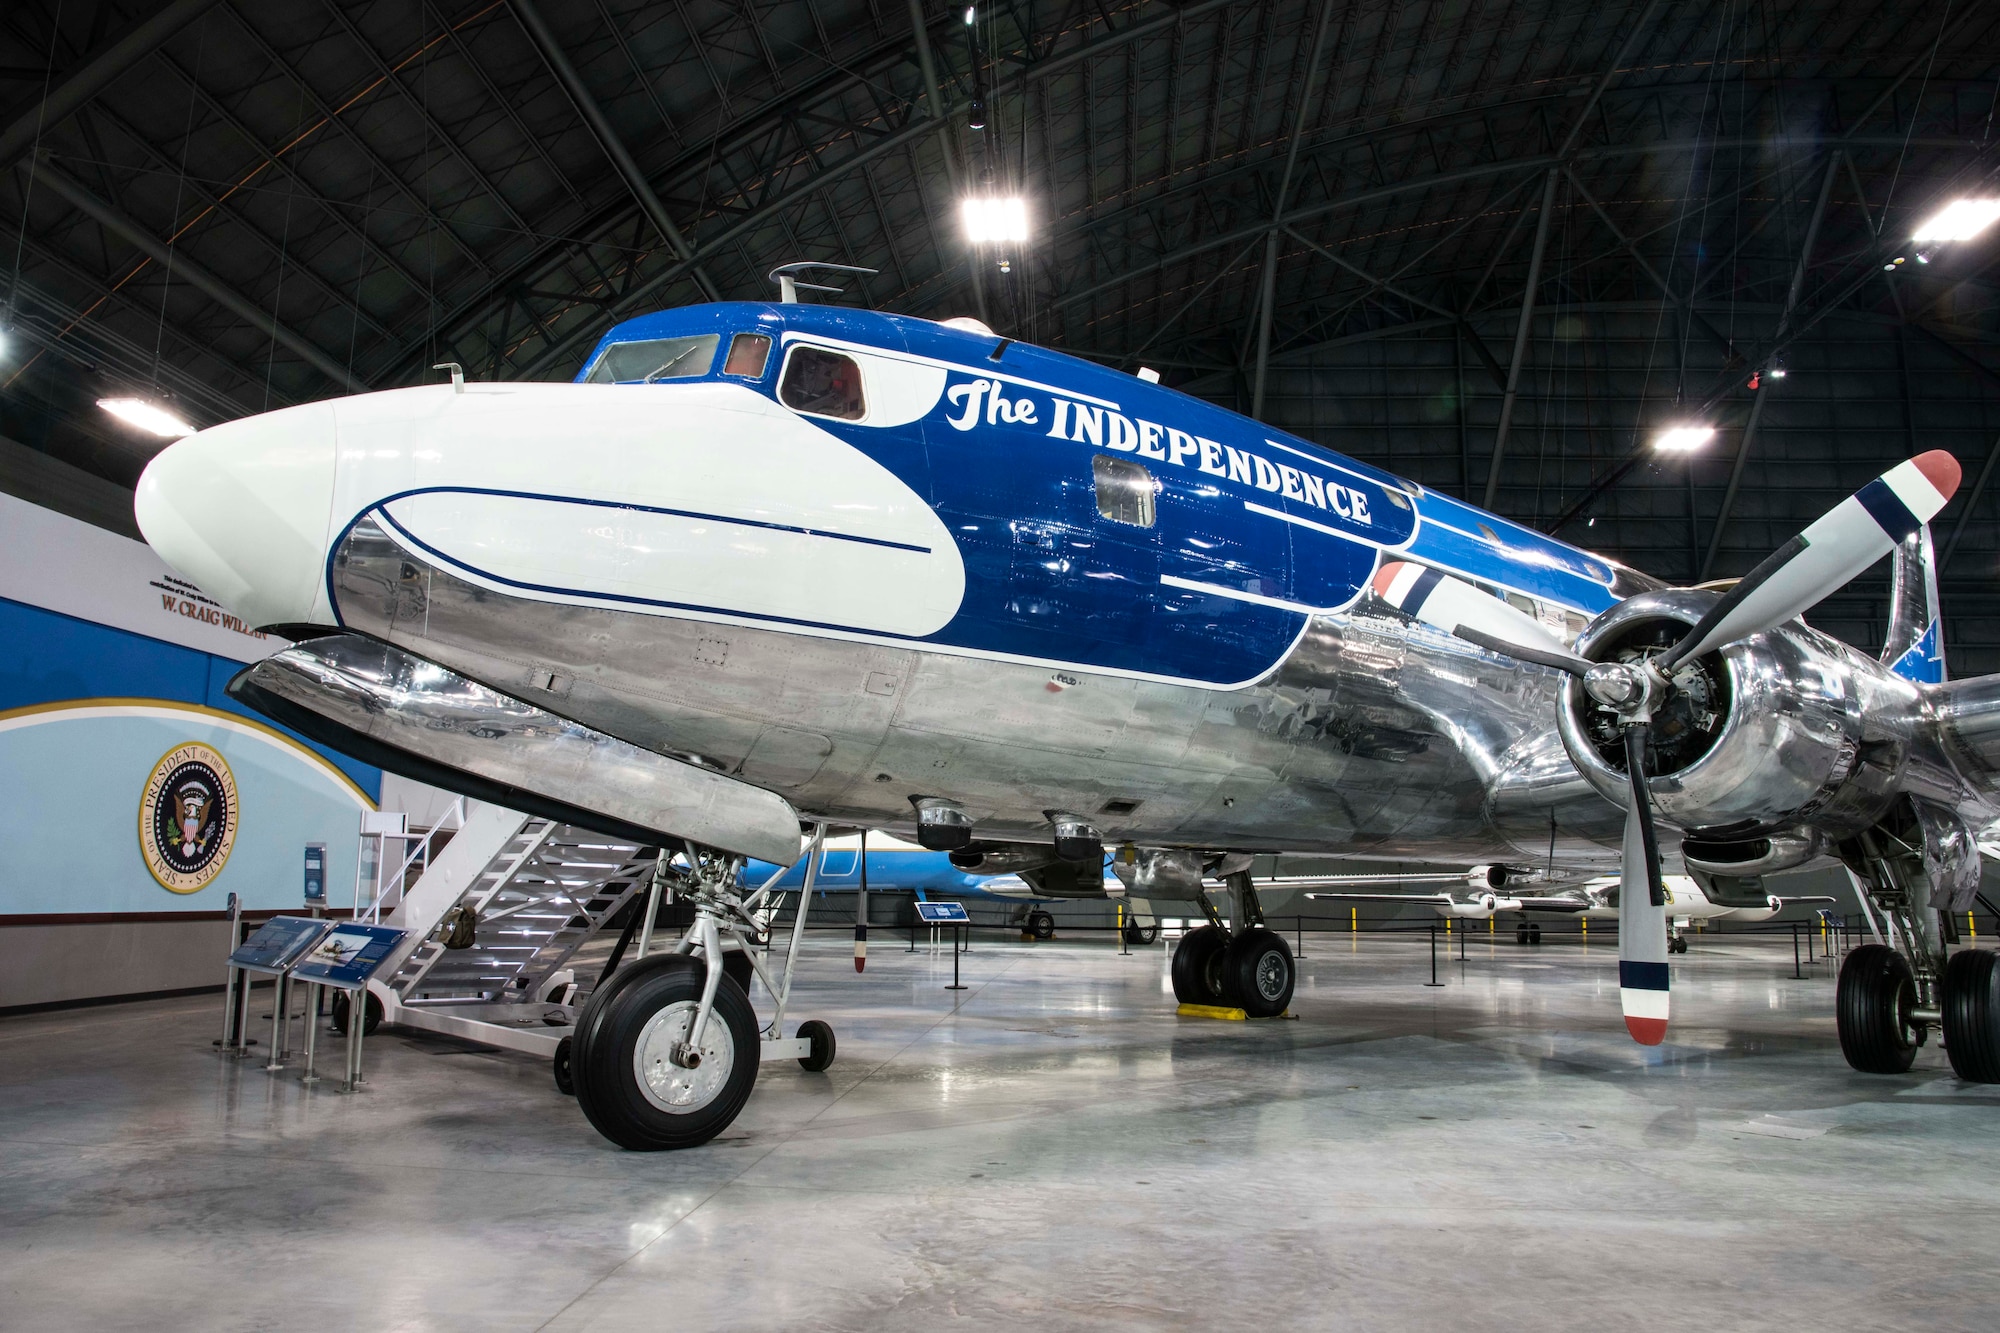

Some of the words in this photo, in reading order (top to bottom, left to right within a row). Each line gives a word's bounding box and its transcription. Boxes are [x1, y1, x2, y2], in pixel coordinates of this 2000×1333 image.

[945, 379, 1038, 431] The
[1046, 398, 1372, 525] INDEPENDENCE
[162, 593, 177, 613] W.
[179, 600, 220, 626] CRAIG
[186, 591, 197, 601] Craig
[200, 750, 210, 760] OF
[210, 755, 223, 772] THE
[146, 747, 197, 809] PRESIDENT
[222, 770, 236, 832] UNITED
[146, 839, 155, 853] OF
[196, 839, 230, 885] STATES
[153, 853, 178, 885] SEAL
